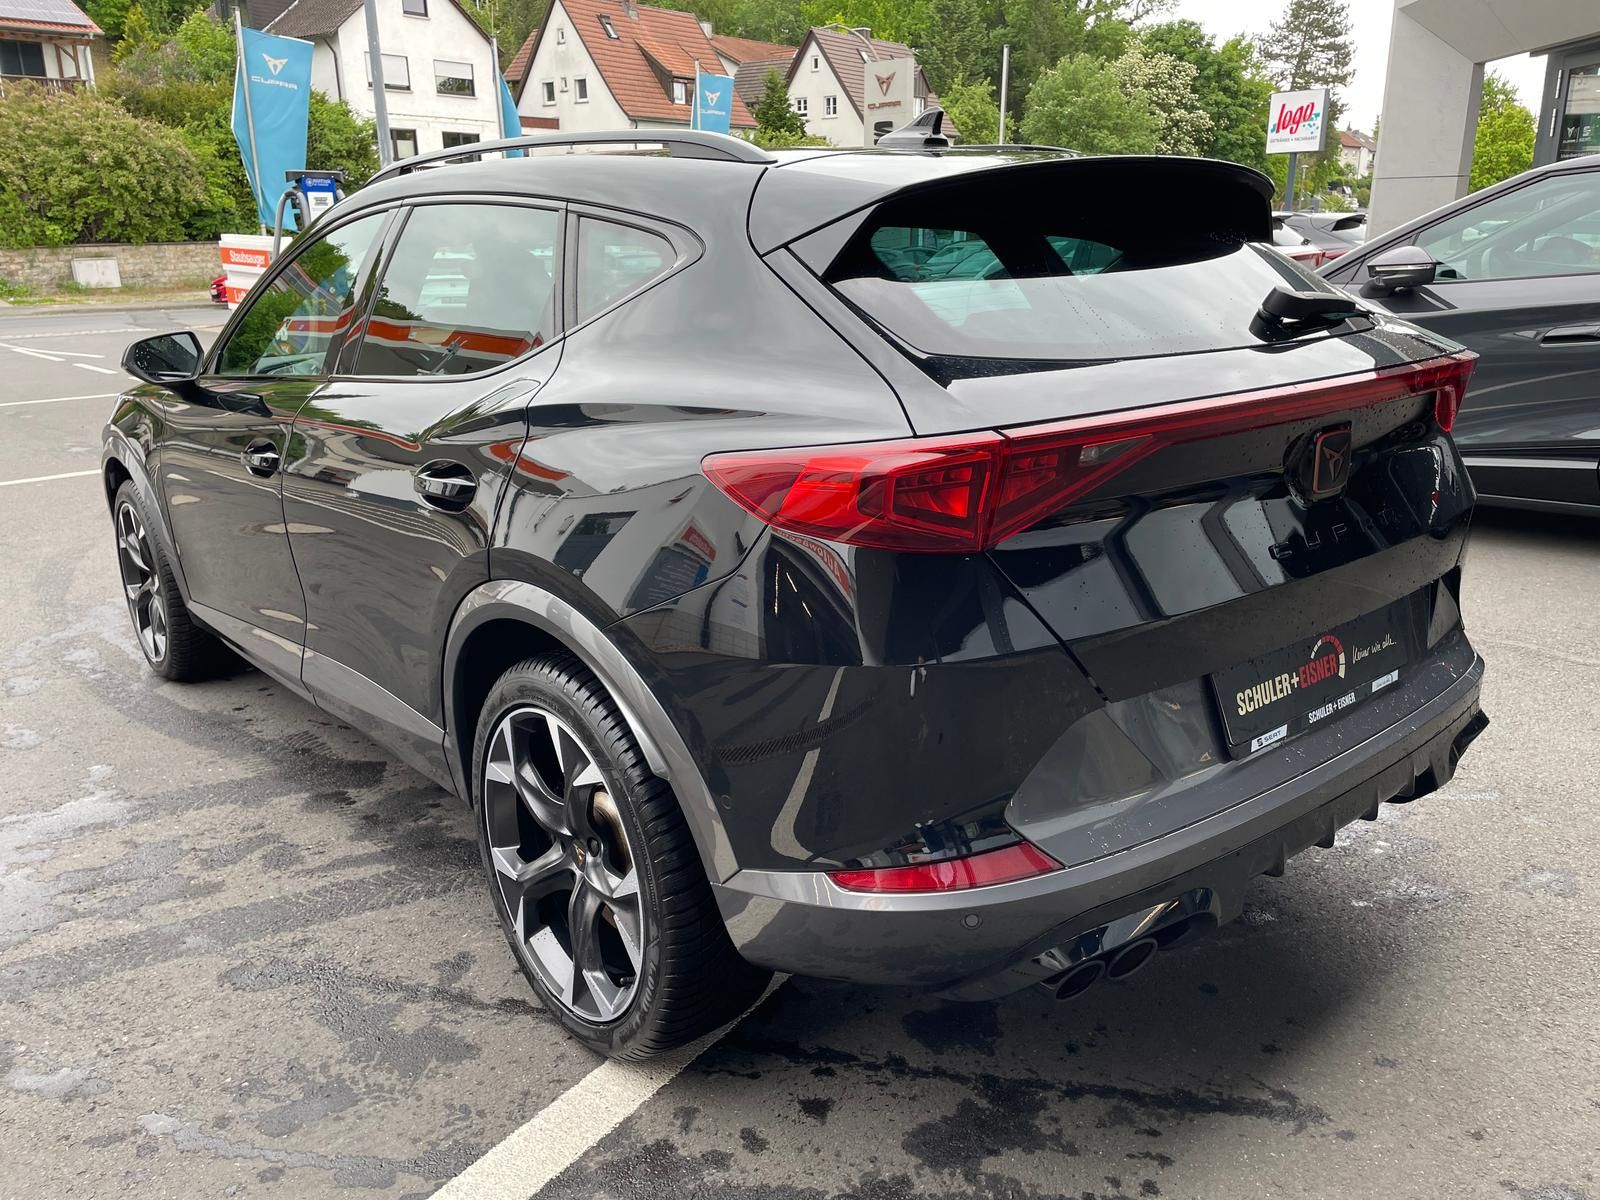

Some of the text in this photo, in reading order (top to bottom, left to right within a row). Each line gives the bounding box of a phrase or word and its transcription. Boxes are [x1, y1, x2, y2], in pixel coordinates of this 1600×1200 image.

[867, 100, 902, 110] CUPRA
[1276, 101, 1315, 134] logo
[229, 249, 266, 268] Staubsauger
[1371, 641, 1382, 654] wie
[1308, 703, 1334, 724] SCHULER
[1337, 692, 1356, 710] EISNER
[1264, 730, 1281, 742] SEAT
